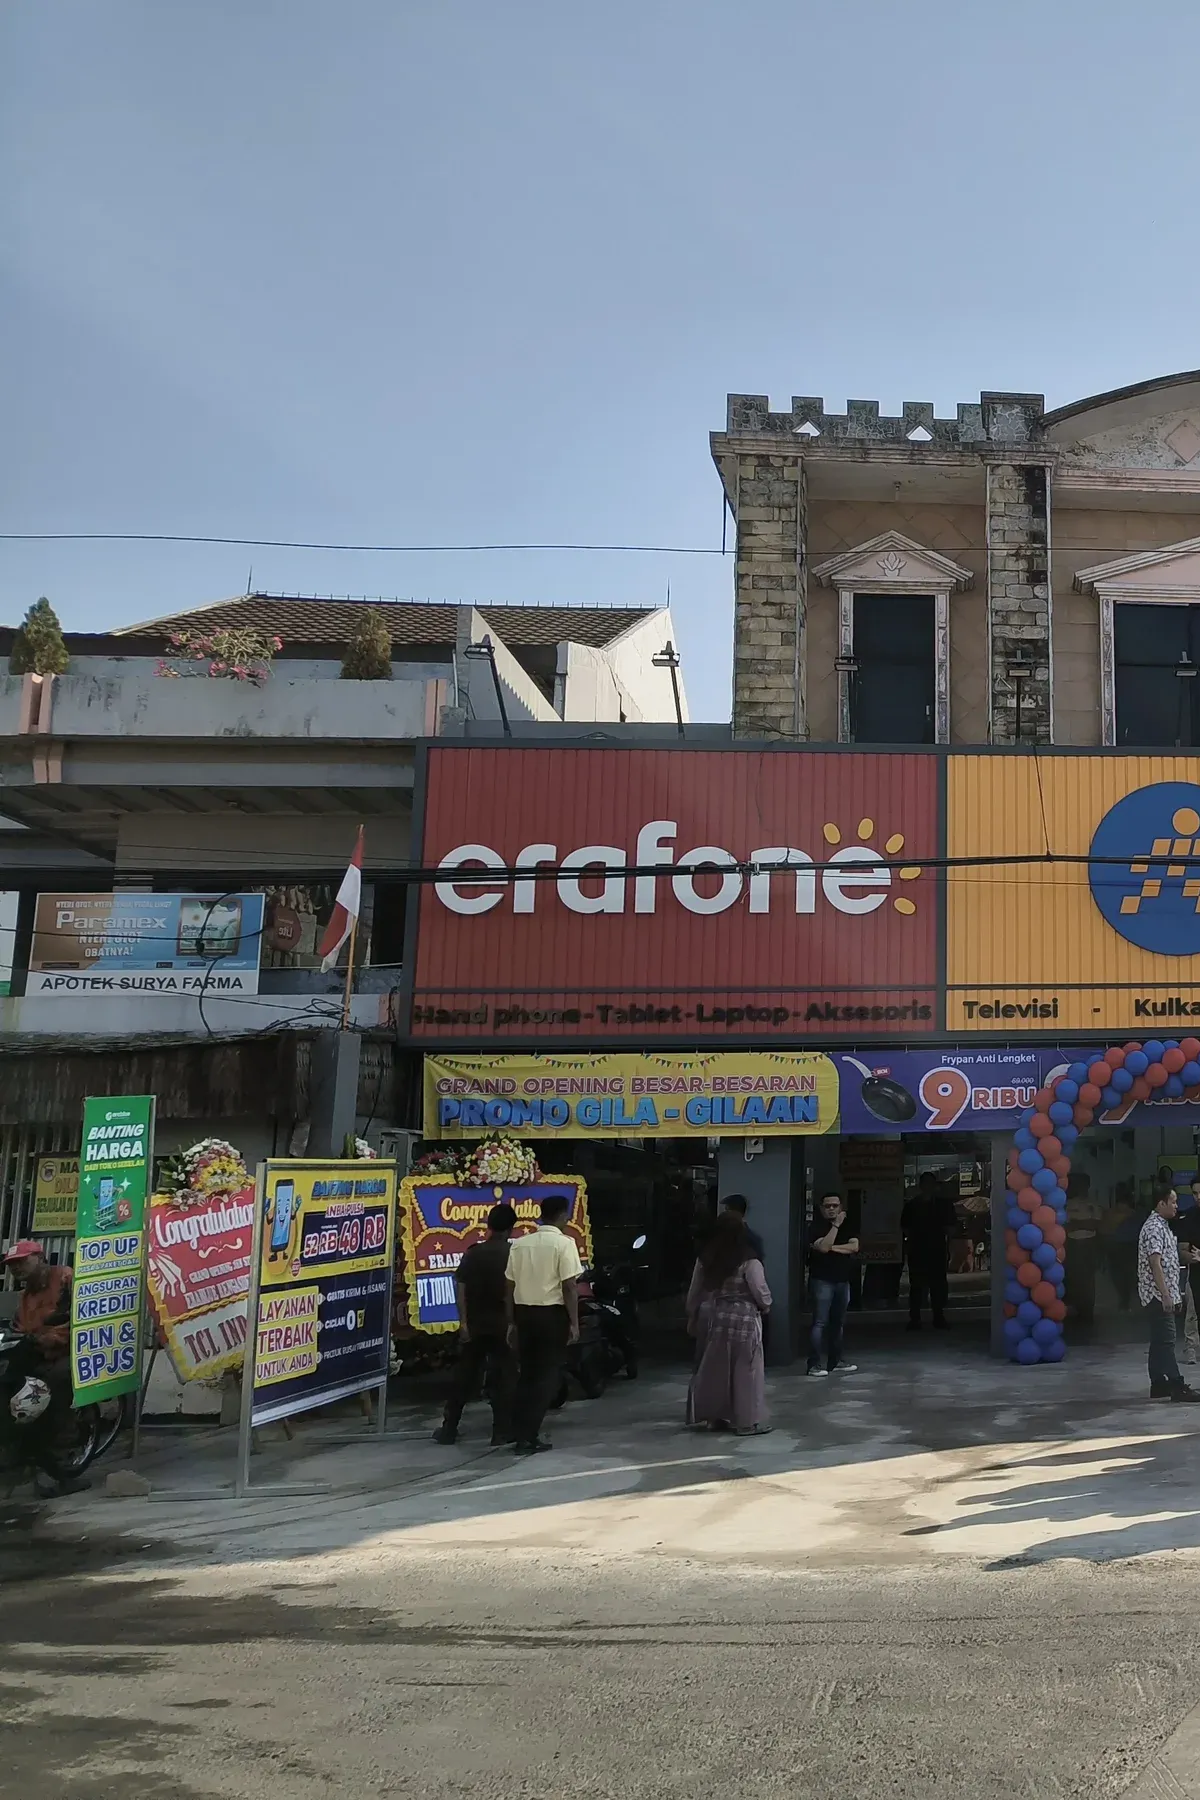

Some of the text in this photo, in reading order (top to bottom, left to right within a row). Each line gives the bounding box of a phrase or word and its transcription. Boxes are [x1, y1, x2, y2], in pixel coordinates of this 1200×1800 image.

[434, 820, 892, 914] erafone
[56, 911, 168, 929] Paramex
[84, 947, 134, 957] OBATNYA!
[41, 977, 243, 990] APOTEK SURYA FARMA
[413, 1000, 932, 1029] Hand phone Tablet Laptop Aksesoris
[963, 998, 1059, 1019] Televisi
[942, 1053, 1036, 1066] Frypan Anti Lengket
[436, 1074, 817, 1095] GRAND OPENING BESAR-BESARAN
[919, 1067, 972, 1130] 9
[972, 1086, 1037, 1110] RIBU
[440, 1096, 570, 1127] PROMO
[576, 1097, 659, 1127] GILA
[686, 1095, 819, 1124] GILAAN
[87, 1123, 144, 1140] BANTING
[86, 1140, 144, 1161] HARGA
[442, 1197, 542, 1226] Congrlatio
[319, 1229, 339, 1256] RB
[339, 1218, 361, 1256] 48
[362, 1213, 386, 1250] RB
[80, 1236, 139, 1262] TOP UP
[428, 1252, 464, 1269] ERAB
[77, 1276, 138, 1297] ANGSURAN
[77, 1292, 138, 1320] KREDIT
[258, 1293, 315, 1323] LAYANAN
[77, 1320, 136, 1355] PLN &
[183, 1327, 221, 1365] TCL
[258, 1320, 315, 1356] TERBAIK
[77, 1346, 135, 1383] BPJS
[256, 1351, 314, 1380] UNTUK ANDA
